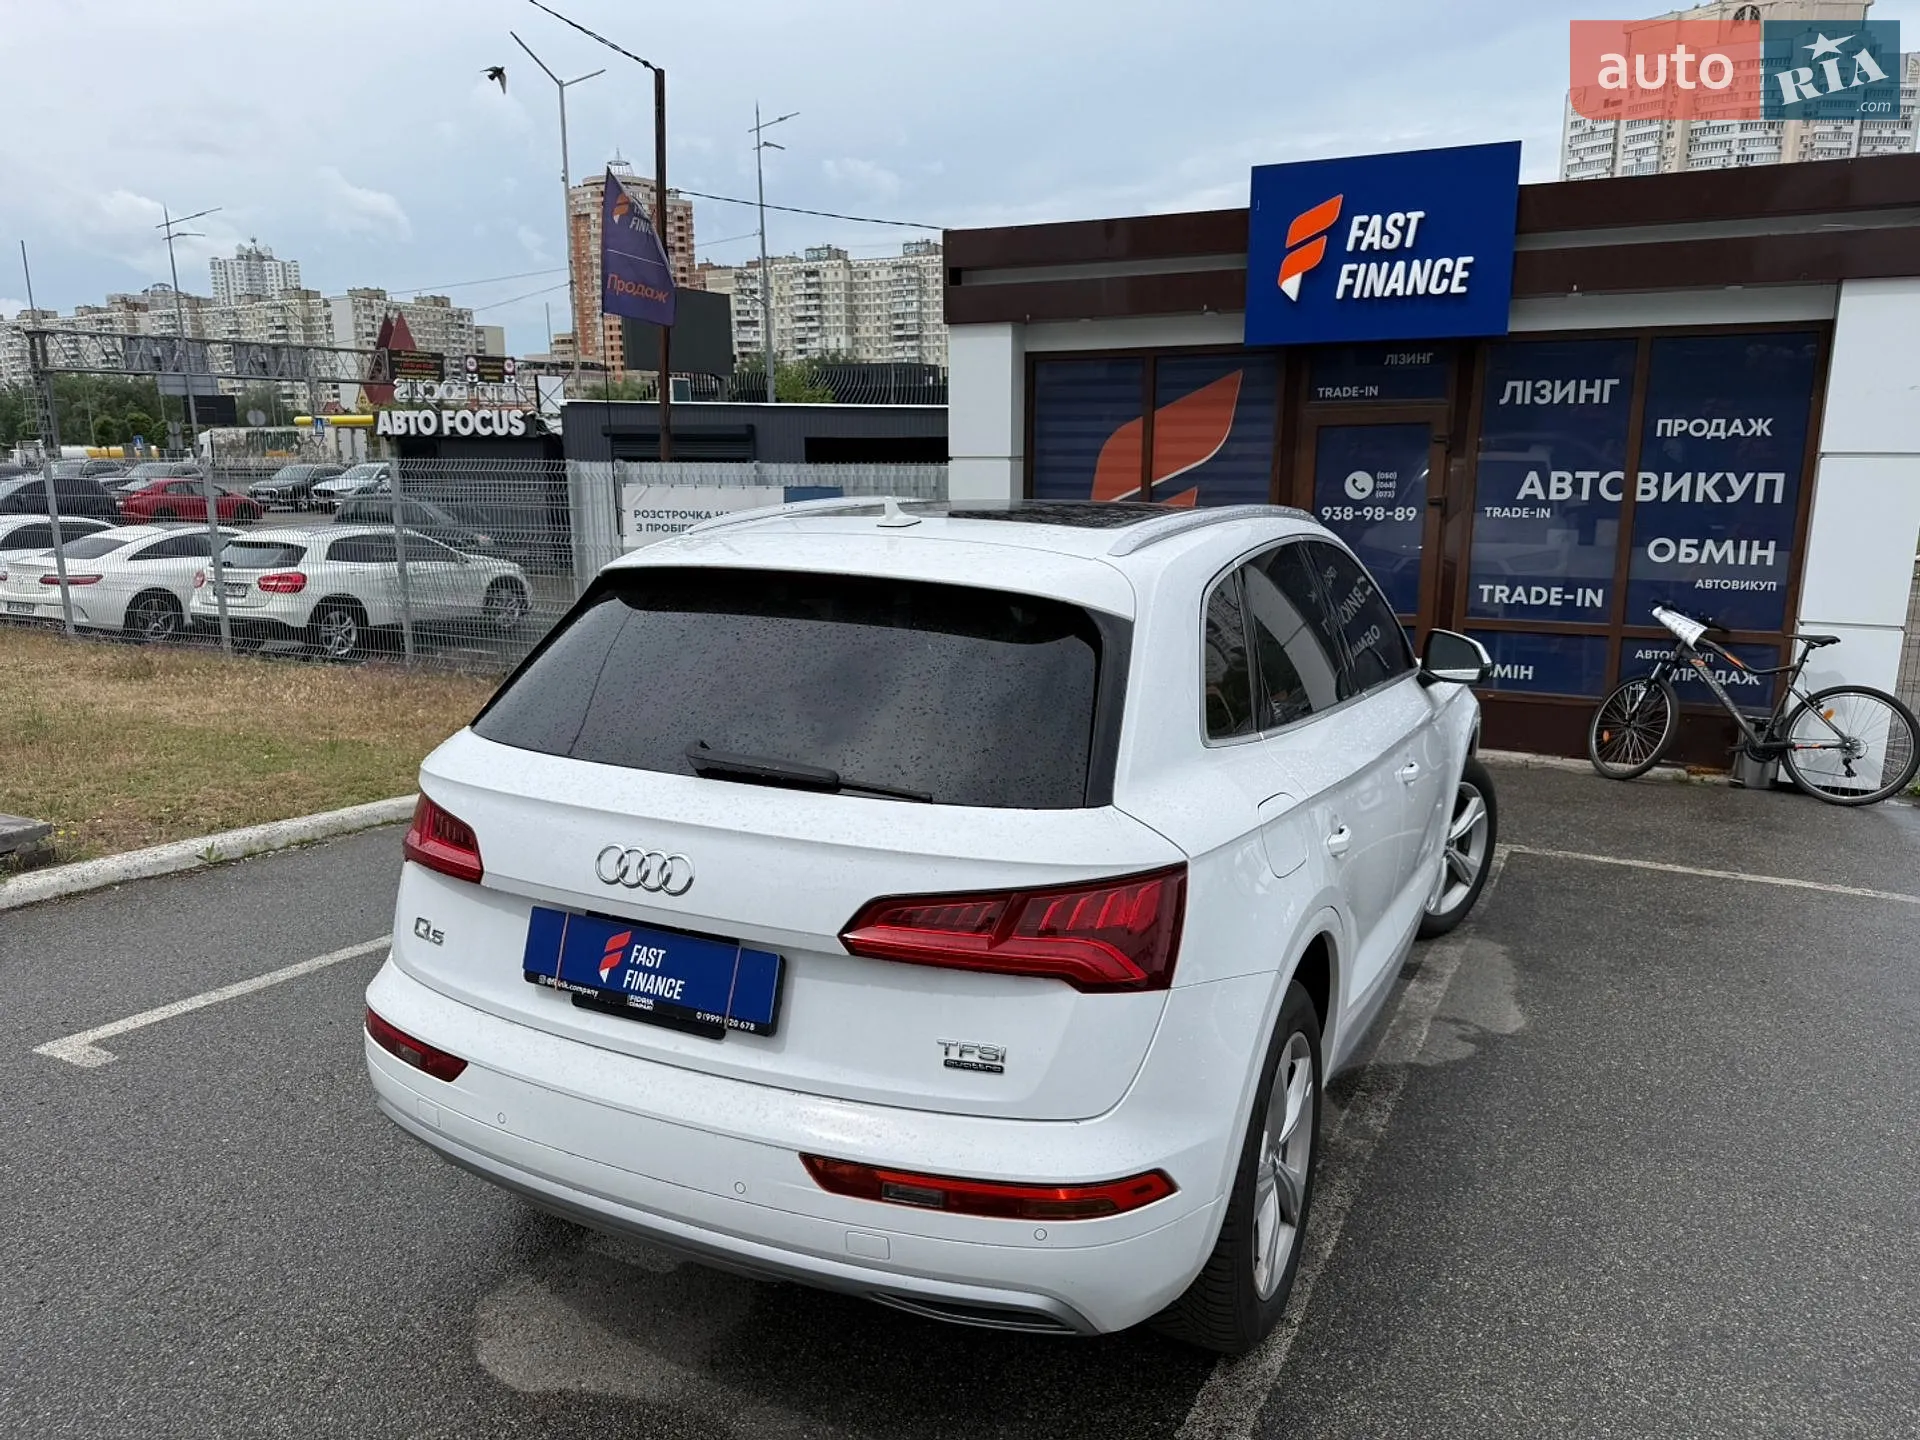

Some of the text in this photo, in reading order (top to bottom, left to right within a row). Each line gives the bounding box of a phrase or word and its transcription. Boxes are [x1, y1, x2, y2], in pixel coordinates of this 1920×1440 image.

[1346, 211, 1425, 252] FAST
[607, 273, 669, 303] Продаж
[1336, 256, 1474, 300] FINANCE
[1384, 352, 1434, 366] ЛІЗИНГ
[1317, 385, 1379, 398] TRADE-IN
[1499, 379, 1620, 405] ЛІЗИНГ
[442, 409, 526, 436] FOCUS
[1656, 418, 1773, 439] ПРОДАЖ
[633, 509, 712, 520] РОЗСТРОЧКА
[1321, 506, 1417, 521] 938-98-89
[1485, 506, 1550, 519] TRADE-IN
[1648, 537, 1777, 566] ОБМІН
[1479, 584, 1603, 608] TRADE-IN
[1695, 579, 1777, 592] АВТОВИКУП
[1675, 667, 1760, 686] ПРДАЖ
[414, 916, 445, 947] Q5
[630, 944, 666, 969] FAST
[623, 970, 685, 1000] FINANCE
[936, 1039, 1006, 1063] TFSI
